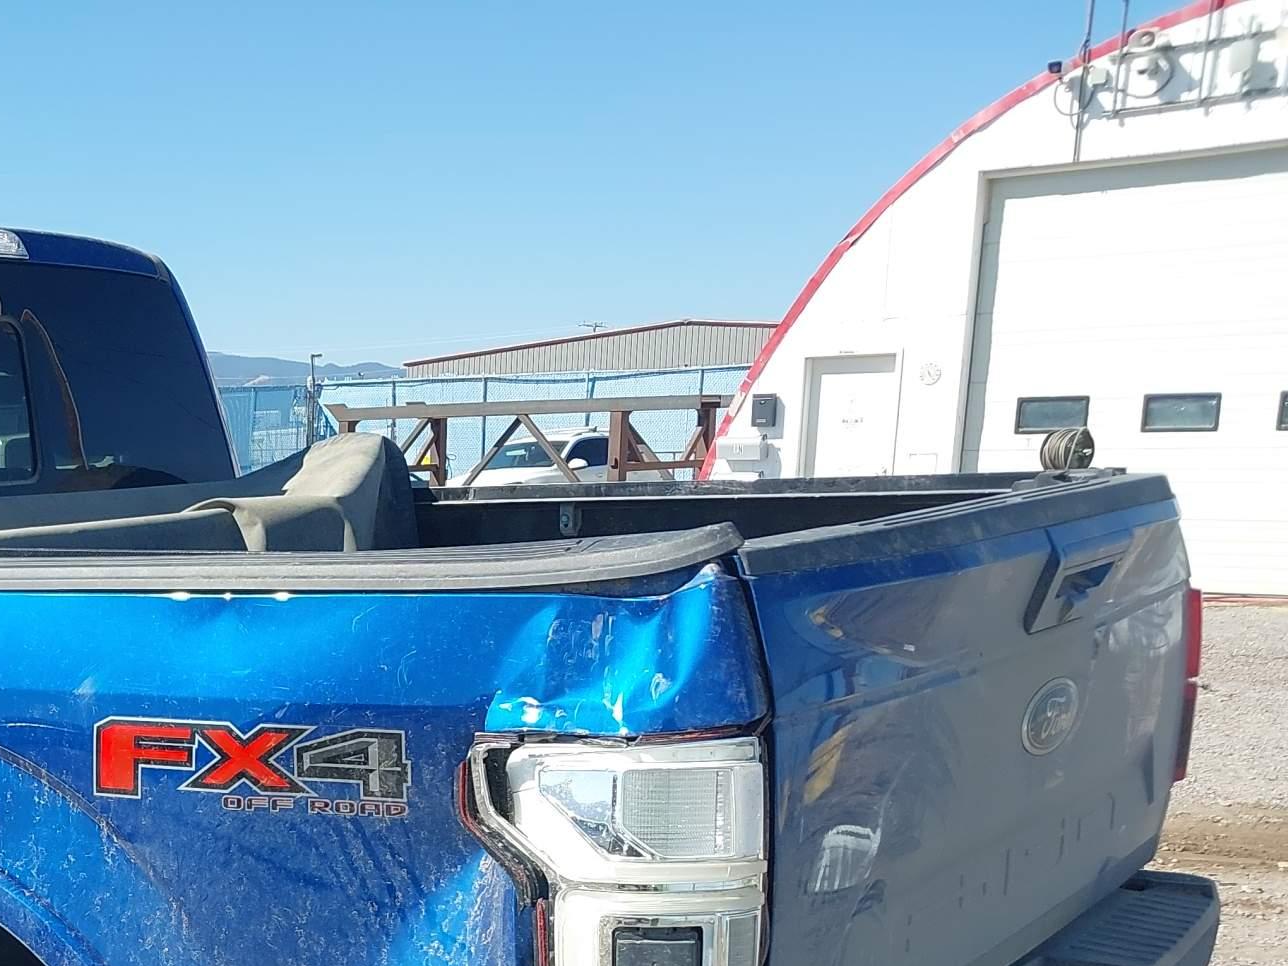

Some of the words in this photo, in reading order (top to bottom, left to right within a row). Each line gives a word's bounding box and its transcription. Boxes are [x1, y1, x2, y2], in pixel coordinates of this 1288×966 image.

[93, 715, 412, 802] FX4
[222, 795, 295, 812] OFF
[308, 798, 409, 817] ROAD
